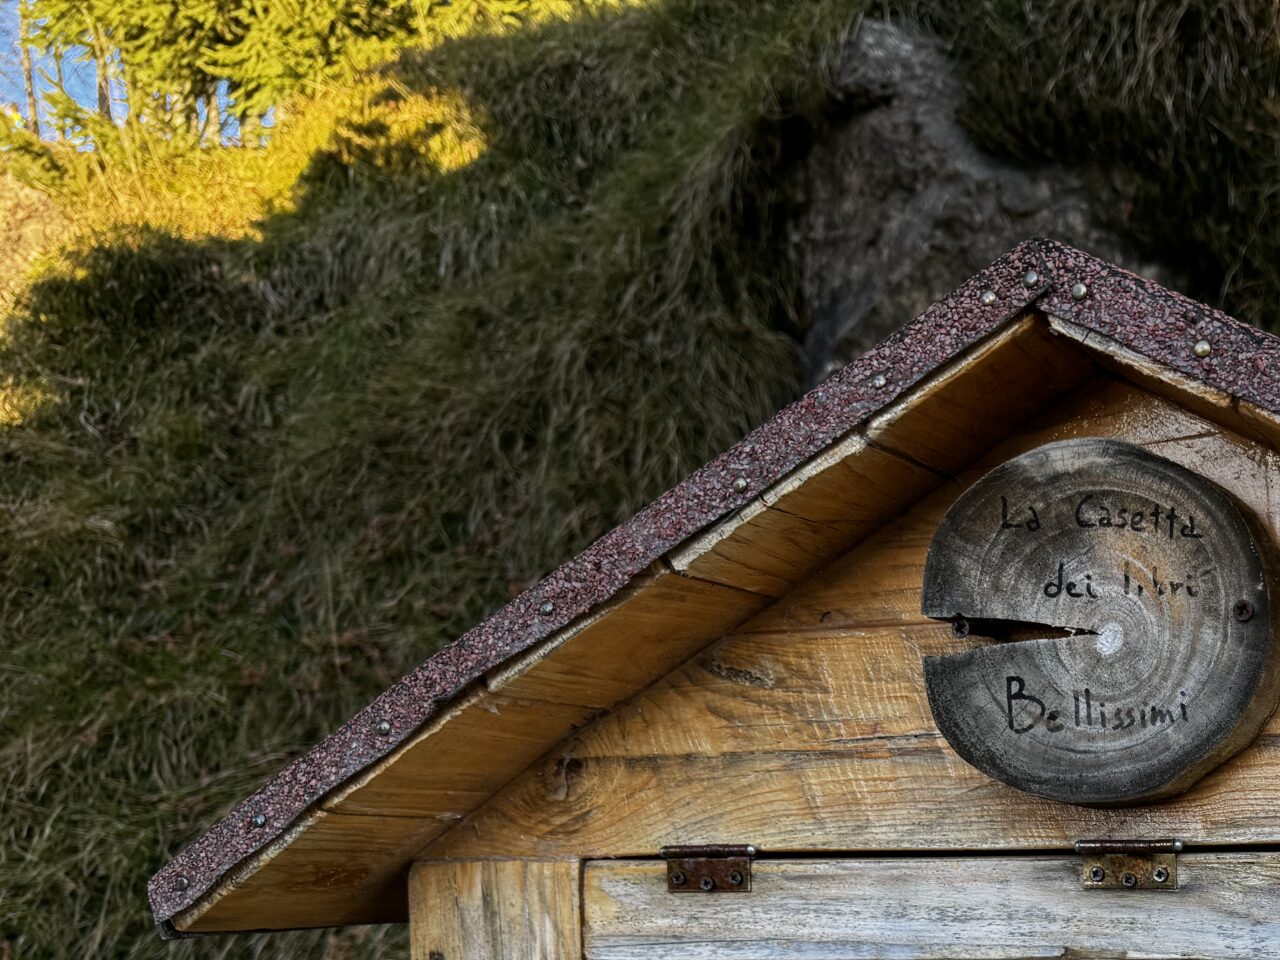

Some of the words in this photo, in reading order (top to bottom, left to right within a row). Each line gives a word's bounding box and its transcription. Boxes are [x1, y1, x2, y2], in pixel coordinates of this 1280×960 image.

[1001, 496, 1041, 532] La
[1076, 494, 1204, 540] Casetta
[1044, 562, 1096, 599] dei
[1123, 561, 1199, 598] libri
[1006, 675, 1190, 735] Bellissimi
